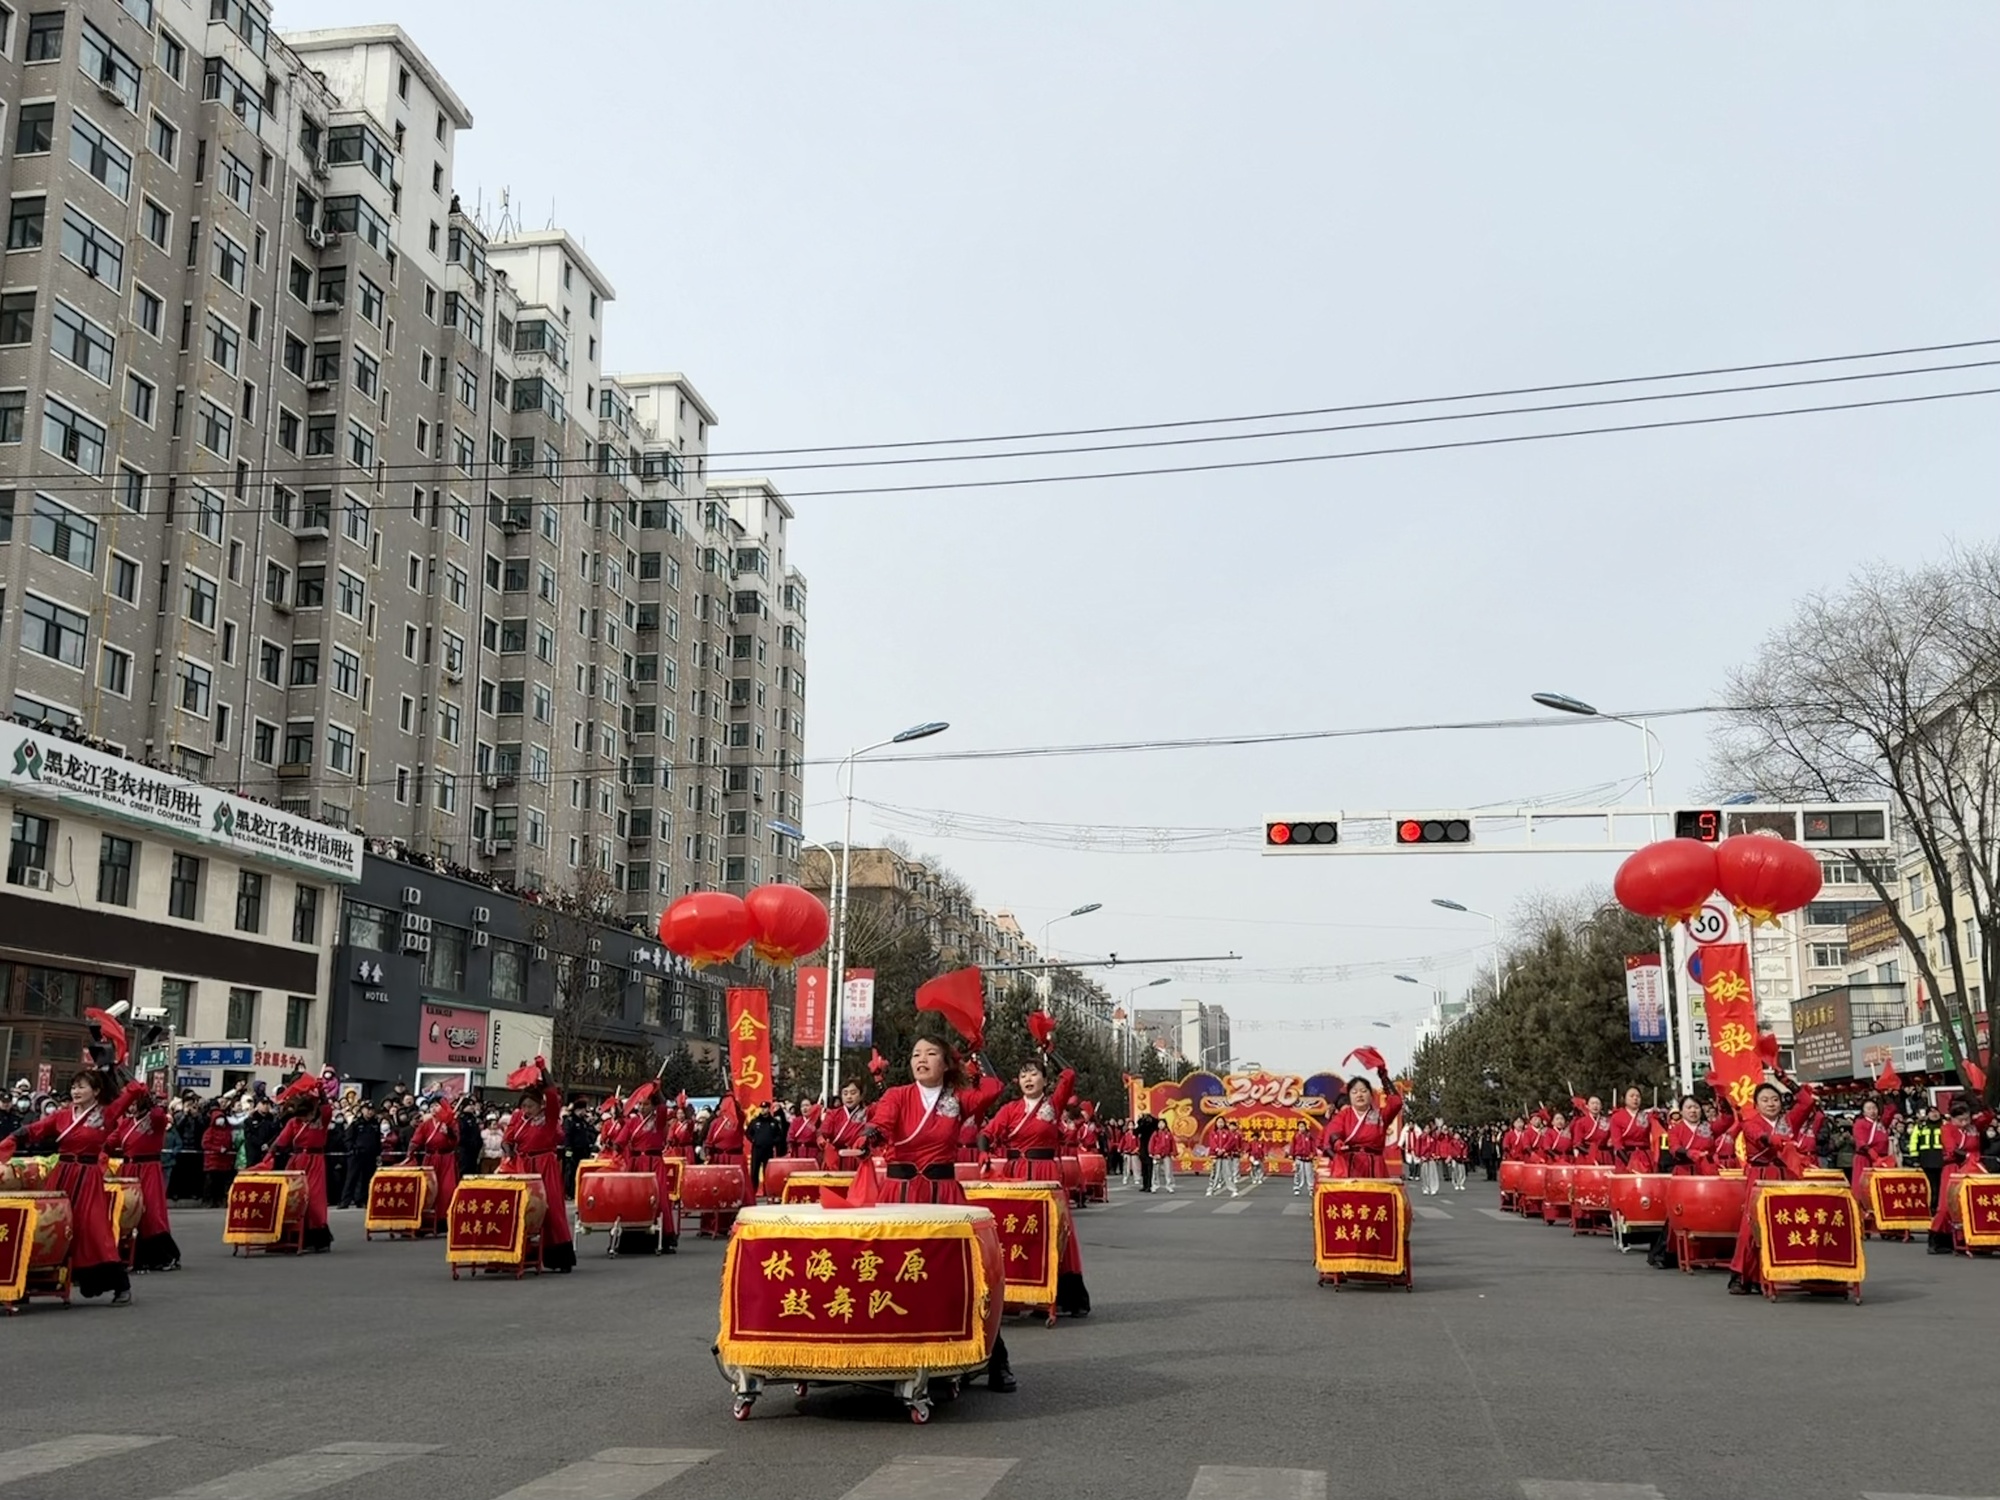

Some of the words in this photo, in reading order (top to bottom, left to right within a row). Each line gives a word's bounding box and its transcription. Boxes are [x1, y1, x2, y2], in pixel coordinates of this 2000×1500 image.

[44, 748, 202, 818] 黑龙江省农村信用社
[43, 775, 100, 798] HEILONGJIANG
[102, 790, 126, 806] RURAL
[129, 801, 155, 814] CREDIT
[157, 809, 201, 828] COOPERATIVE
[235, 808, 354, 863] 黑龙江省农村信用社
[1699, 813, 1716, 840] 9
[279, 845, 296, 856] RURAL
[299, 851, 318, 861] CREDIT
[1694, 915, 1720, 933] 30
[365, 991, 389, 1002] HOTEL
[1227, 1077, 1300, 1106] 2026
[456, 1198, 510, 1215] 林海雪原
[1326, 1203, 1388, 1222] 林海雪原
[1002, 1213, 1038, 1235] 雪原
[1774, 1208, 1846, 1227] 林海雪原
[1335, 1224, 1380, 1241] 鼓舞队
[1787, 1229, 1839, 1247] 鼓舞队
[1000, 1243, 1029, 1262] 队
[761, 1248, 929, 1284] 林海雪原
[778, 1285, 909, 1323] 鼓舞队
